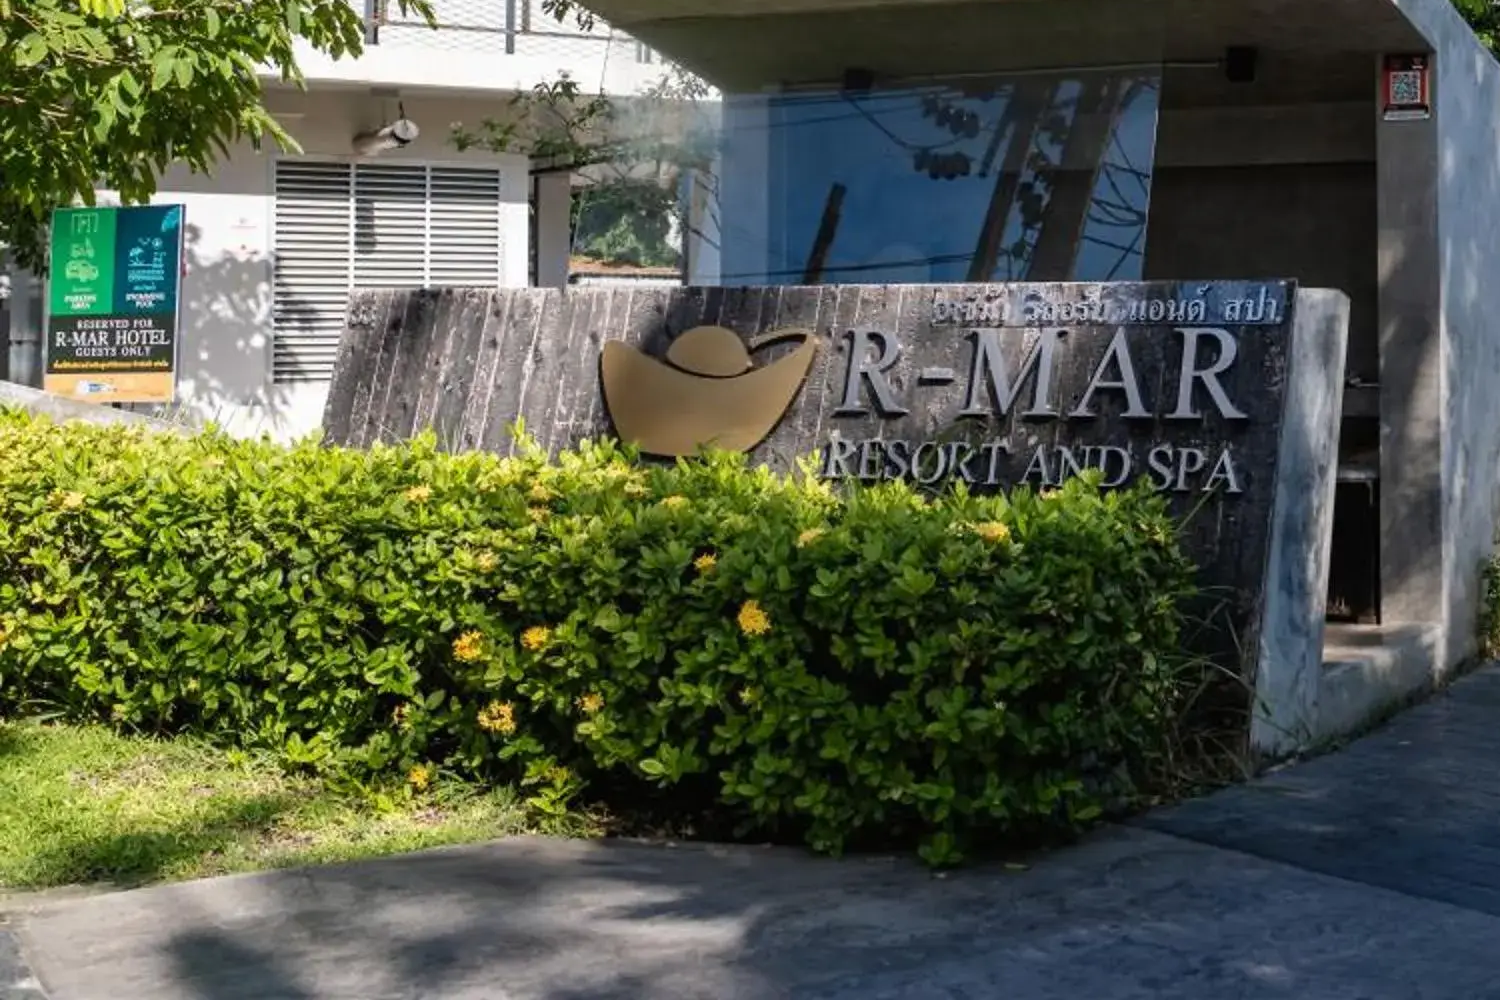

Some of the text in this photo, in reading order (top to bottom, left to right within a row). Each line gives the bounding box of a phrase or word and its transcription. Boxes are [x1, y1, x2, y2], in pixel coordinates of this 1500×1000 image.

[1130, 285, 1211, 322] แอนด์
[1223, 285, 1279, 322] สปา
[77, 318, 153, 329] RESERVED FOR
[55, 330, 171, 347] R-MAR HOTEL
[75, 345, 151, 357] GUESTS ONLY
[830, 326, 1250, 420] R-MAR
[821, 434, 1243, 493] RESORT AND SPA
